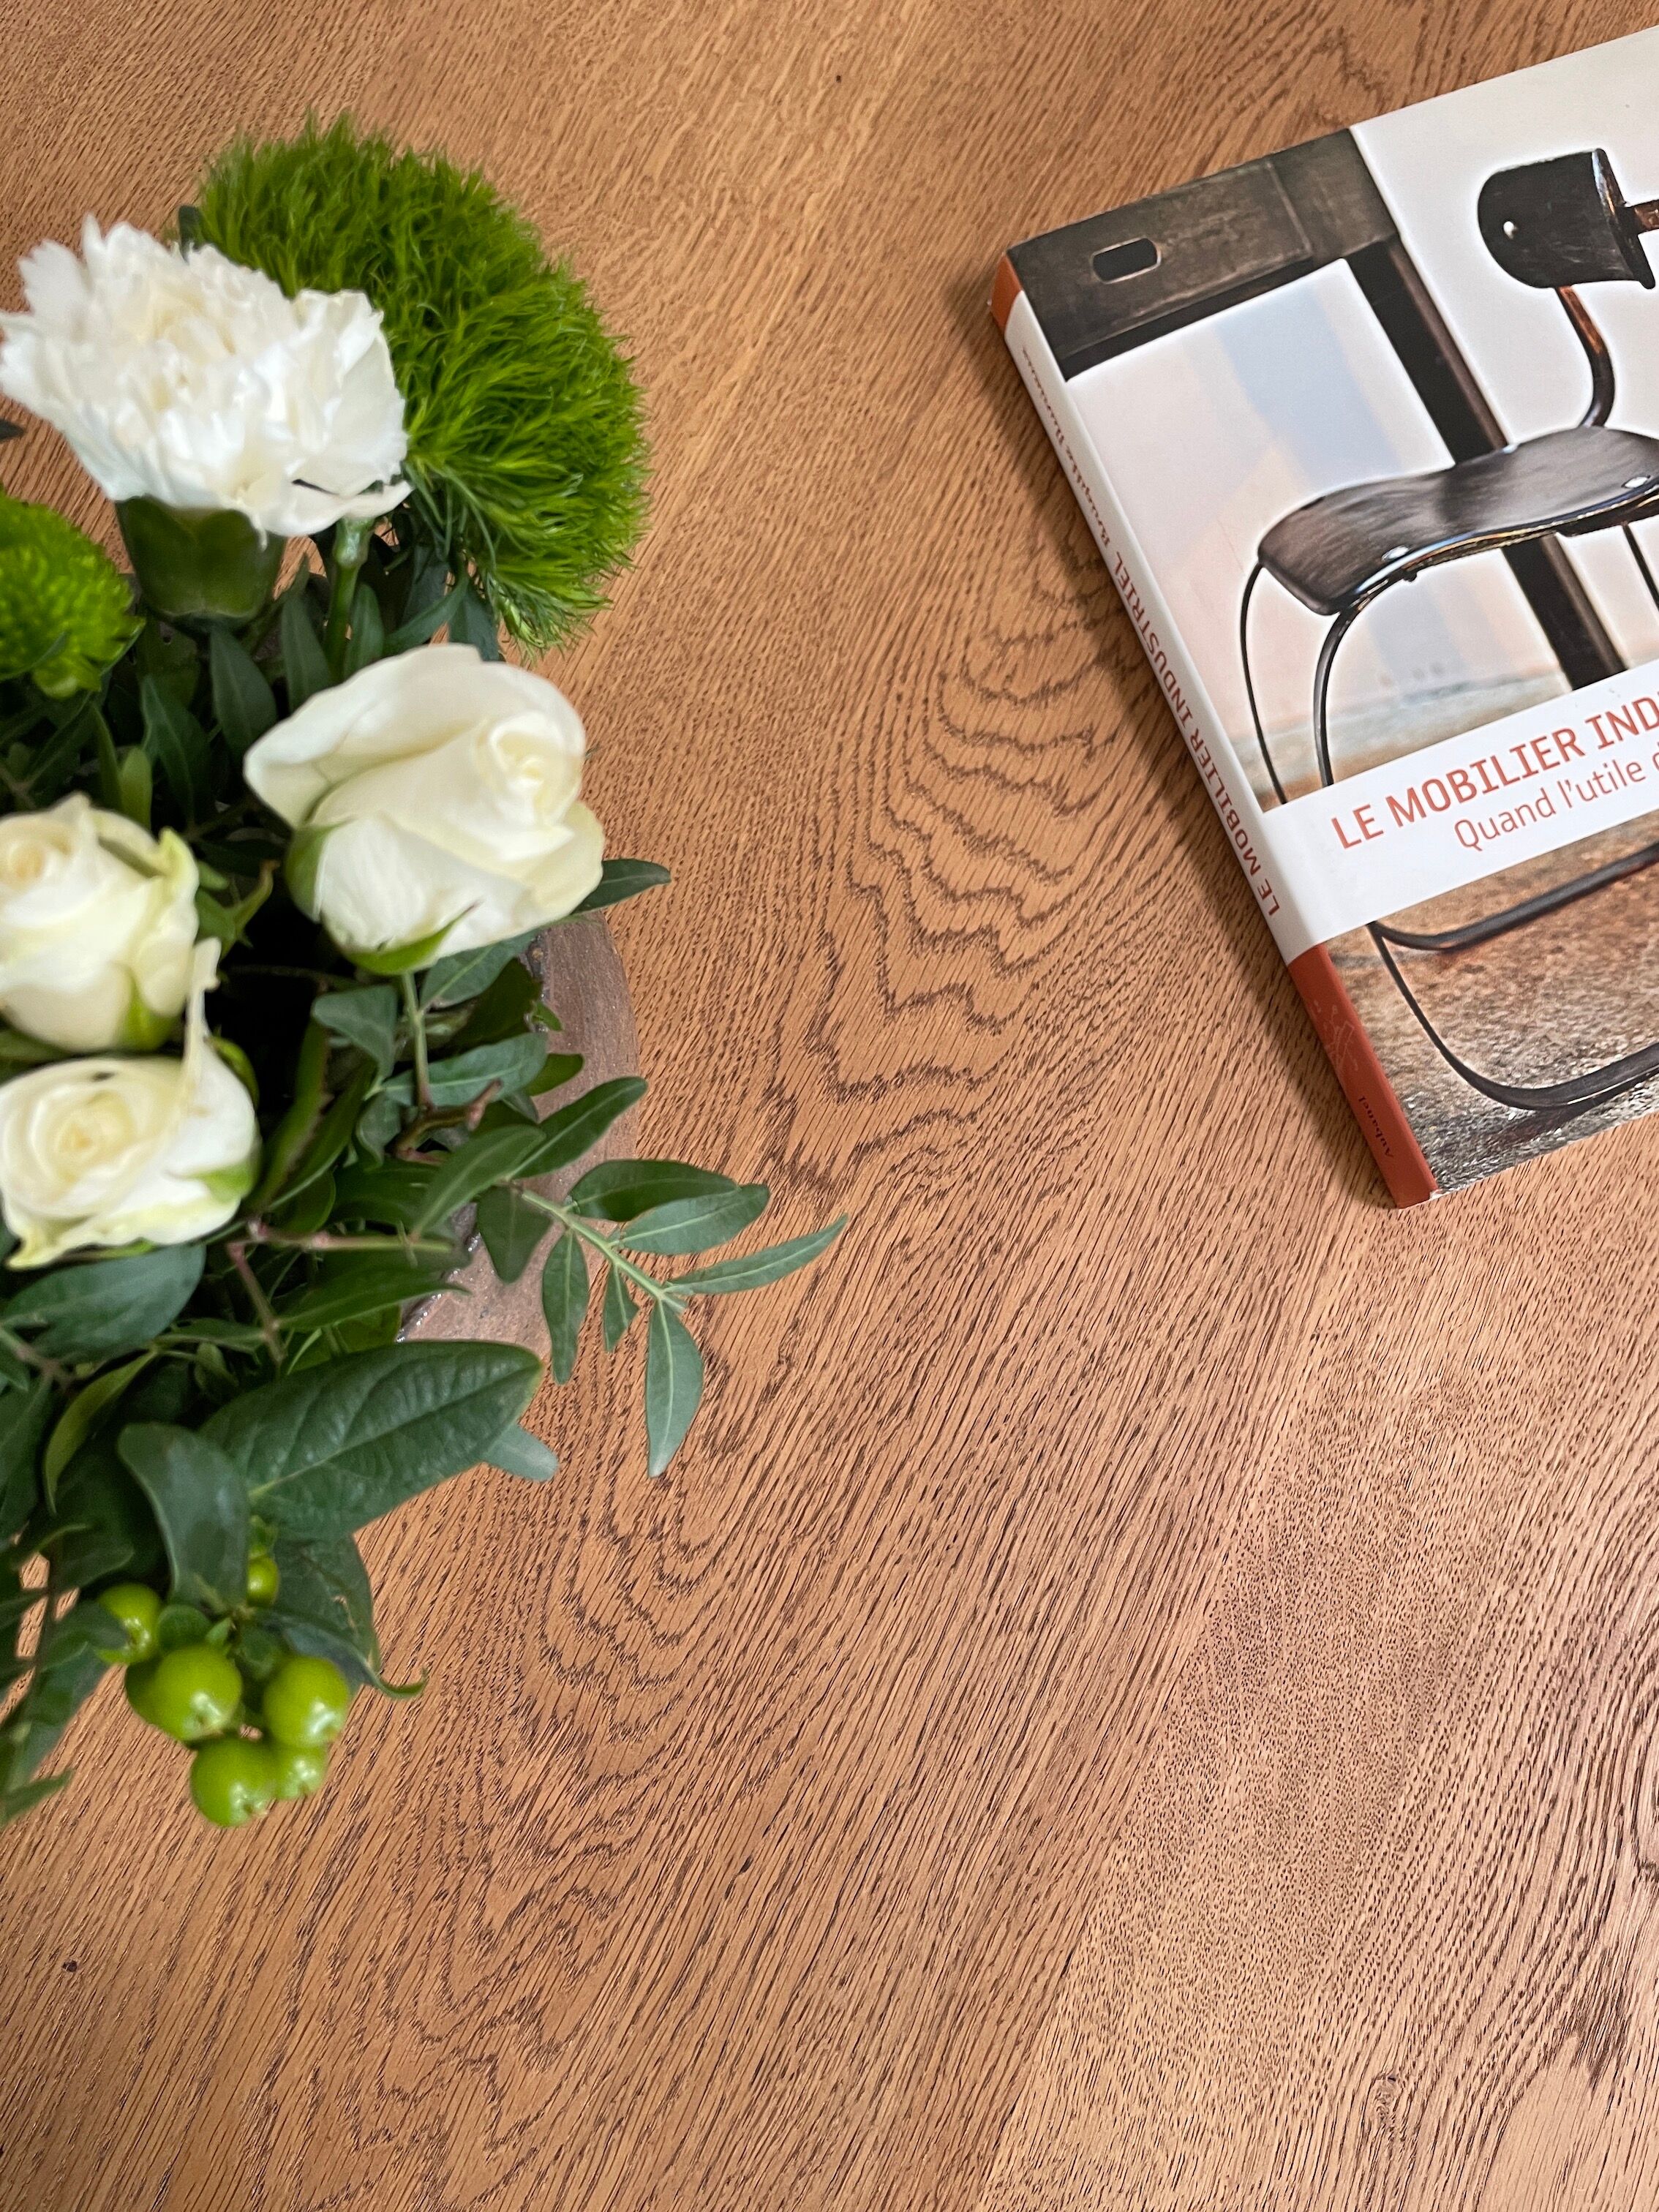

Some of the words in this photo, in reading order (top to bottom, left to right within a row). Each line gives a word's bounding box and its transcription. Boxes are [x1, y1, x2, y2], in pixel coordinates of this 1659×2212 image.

[1116, 551, 1192, 728] INDUSTRIEL
[1189, 728, 1261, 876] MOBILIER
[1331, 804, 1384, 849] LE
[1385, 728, 1585, 827] MOBILIER
[1585, 691, 1659, 749] IND
[1453, 788, 1557, 852] Quand
[1257, 878, 1280, 916] LE
